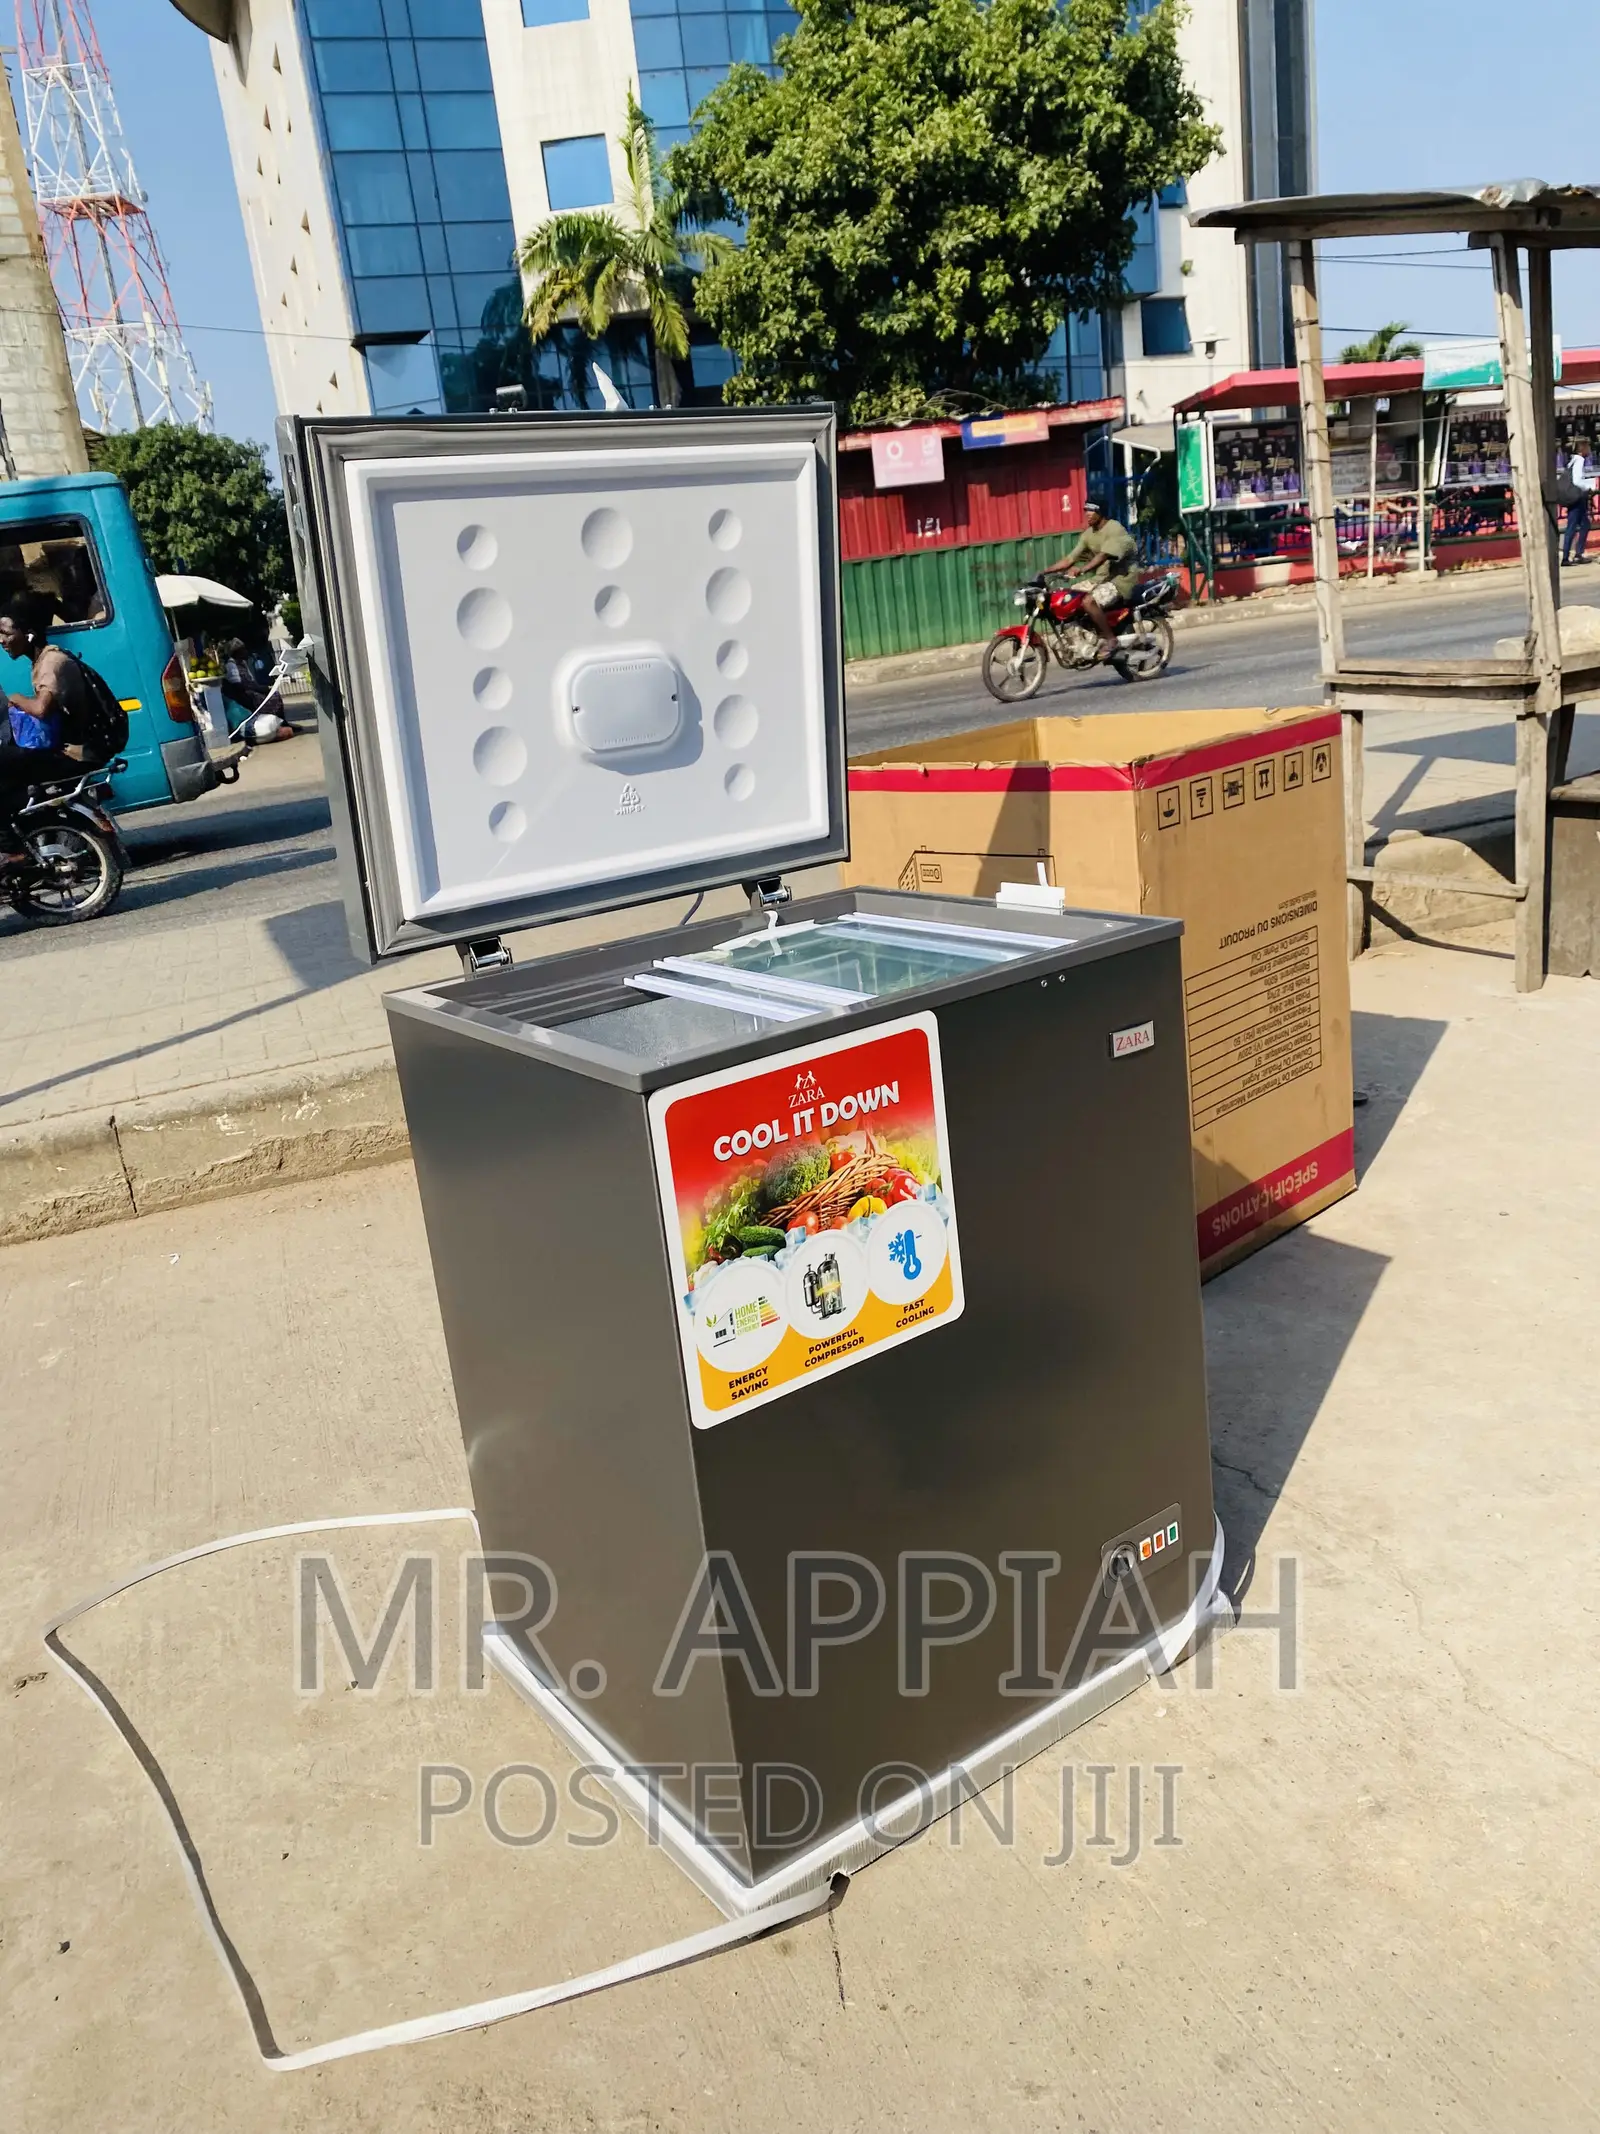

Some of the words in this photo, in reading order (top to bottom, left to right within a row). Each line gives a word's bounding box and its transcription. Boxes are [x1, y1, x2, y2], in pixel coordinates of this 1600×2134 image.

[1270, 901, 1317, 927] DIMENSIONS
[1218, 925, 1255, 948] PRODUIT
[1257, 920, 1268, 932] DU
[1115, 1030, 1150, 1052] ZARA
[788, 1086, 825, 1108] ZARA
[713, 1119, 788, 1161] COOL
[792, 1108, 814, 1137] IT
[820, 1081, 900, 1127] DOWN
[1211, 1160, 1318, 1237] SPÉCIFICATIONS
[734, 1301, 758, 1320] HOME
[896, 1306, 935, 1328] COOLING
[903, 1299, 925, 1314] FAST
[736, 1314, 759, 1329] ENERGY
[804, 1336, 865, 1368] COMPRESSOR
[808, 1328, 859, 1355] POWERFUL
[729, 1366, 769, 1389] ENERGY
[731, 1378, 769, 1400] SAVING
